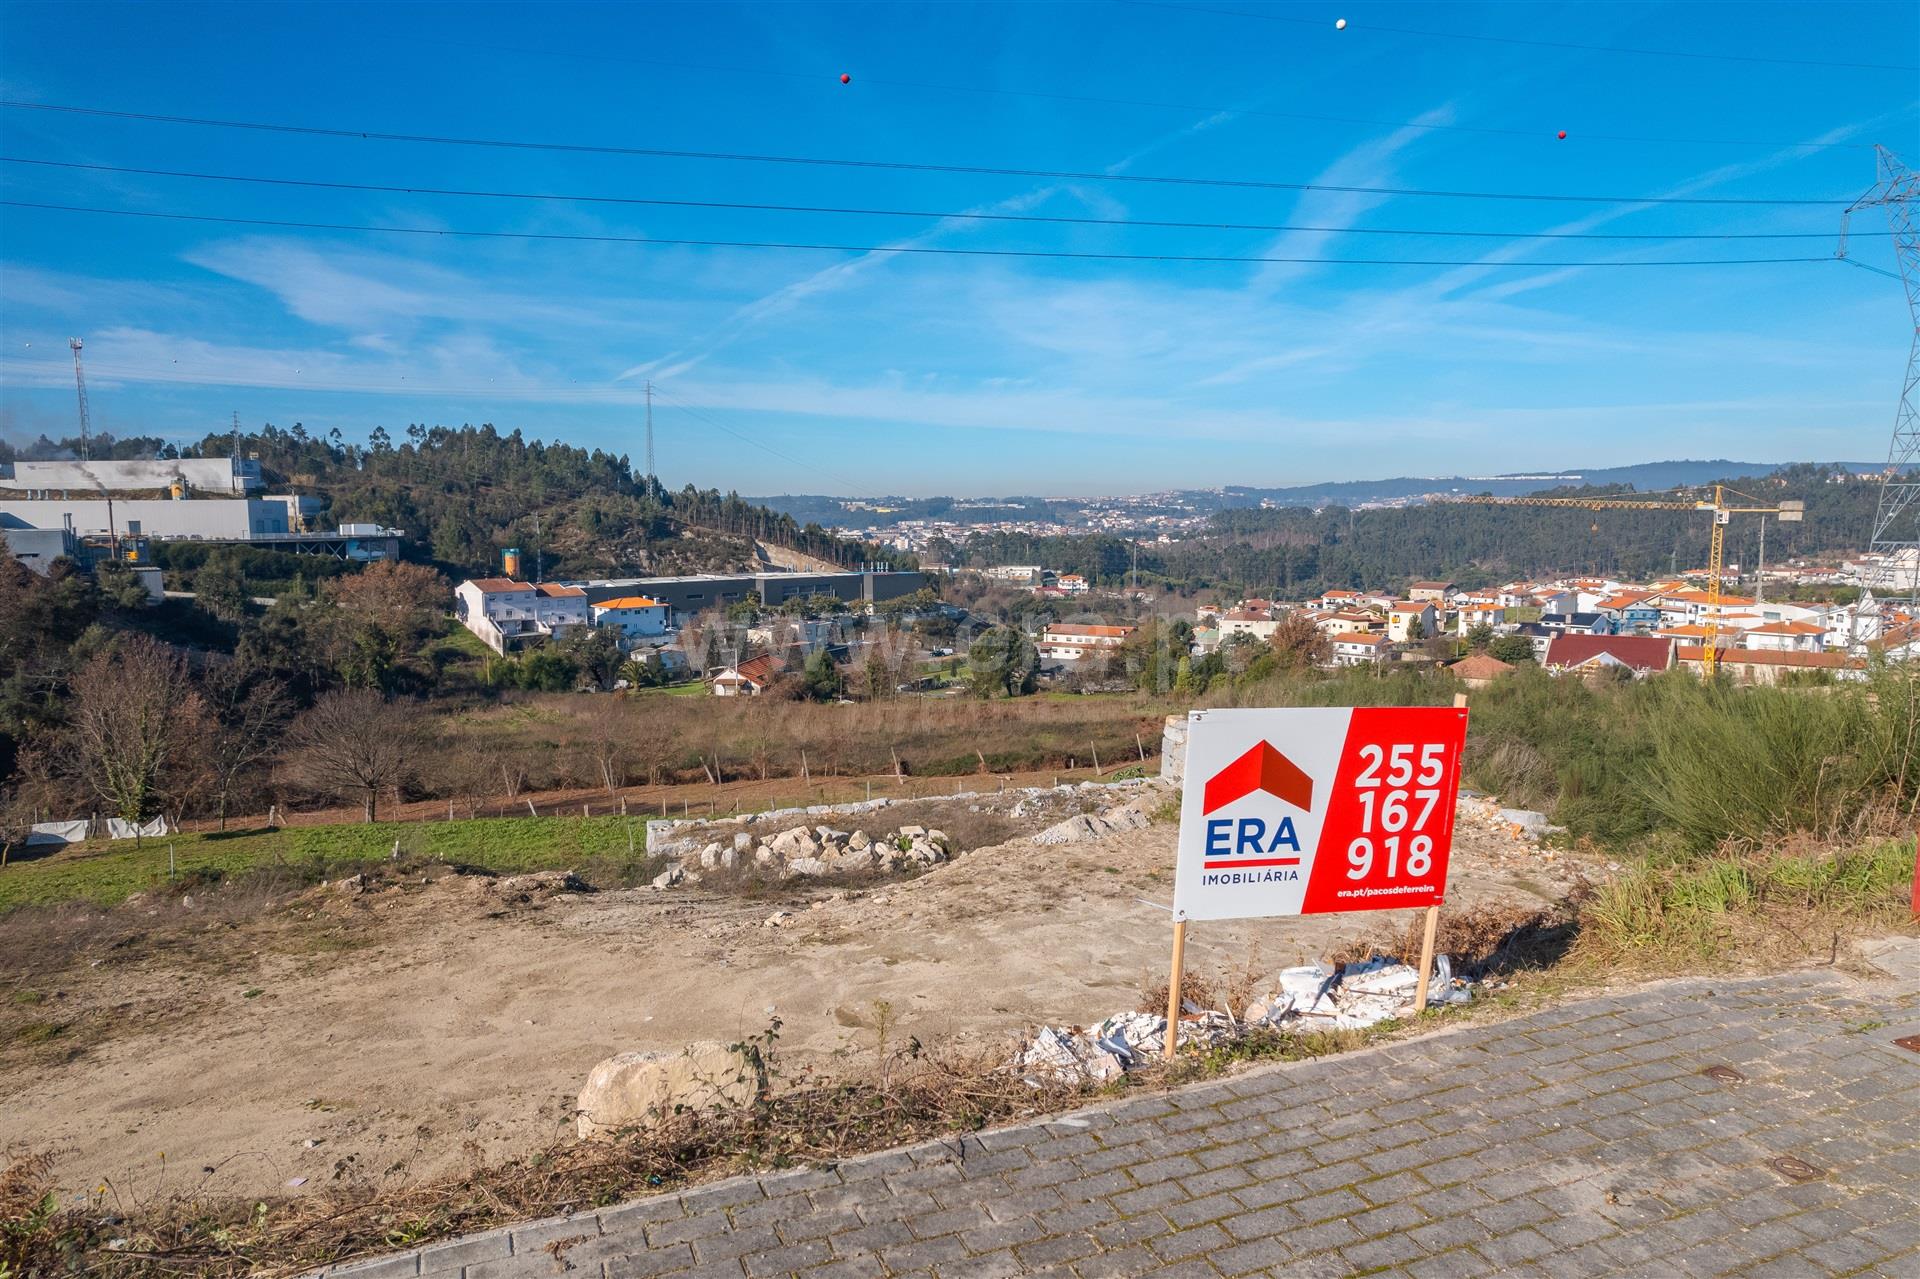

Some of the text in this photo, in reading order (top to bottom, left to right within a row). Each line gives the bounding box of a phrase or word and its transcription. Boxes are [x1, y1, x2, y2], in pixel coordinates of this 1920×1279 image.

[1355, 743, 1445, 787] 255
[1359, 789, 1440, 833] 167
[1205, 816, 1301, 856] ERA
[1203, 869, 1299, 886] IMOBILIÁRIA
[1346, 835, 1433, 880] 918
[1337, 885, 1435, 898] era.pt/pacosdeferreira
